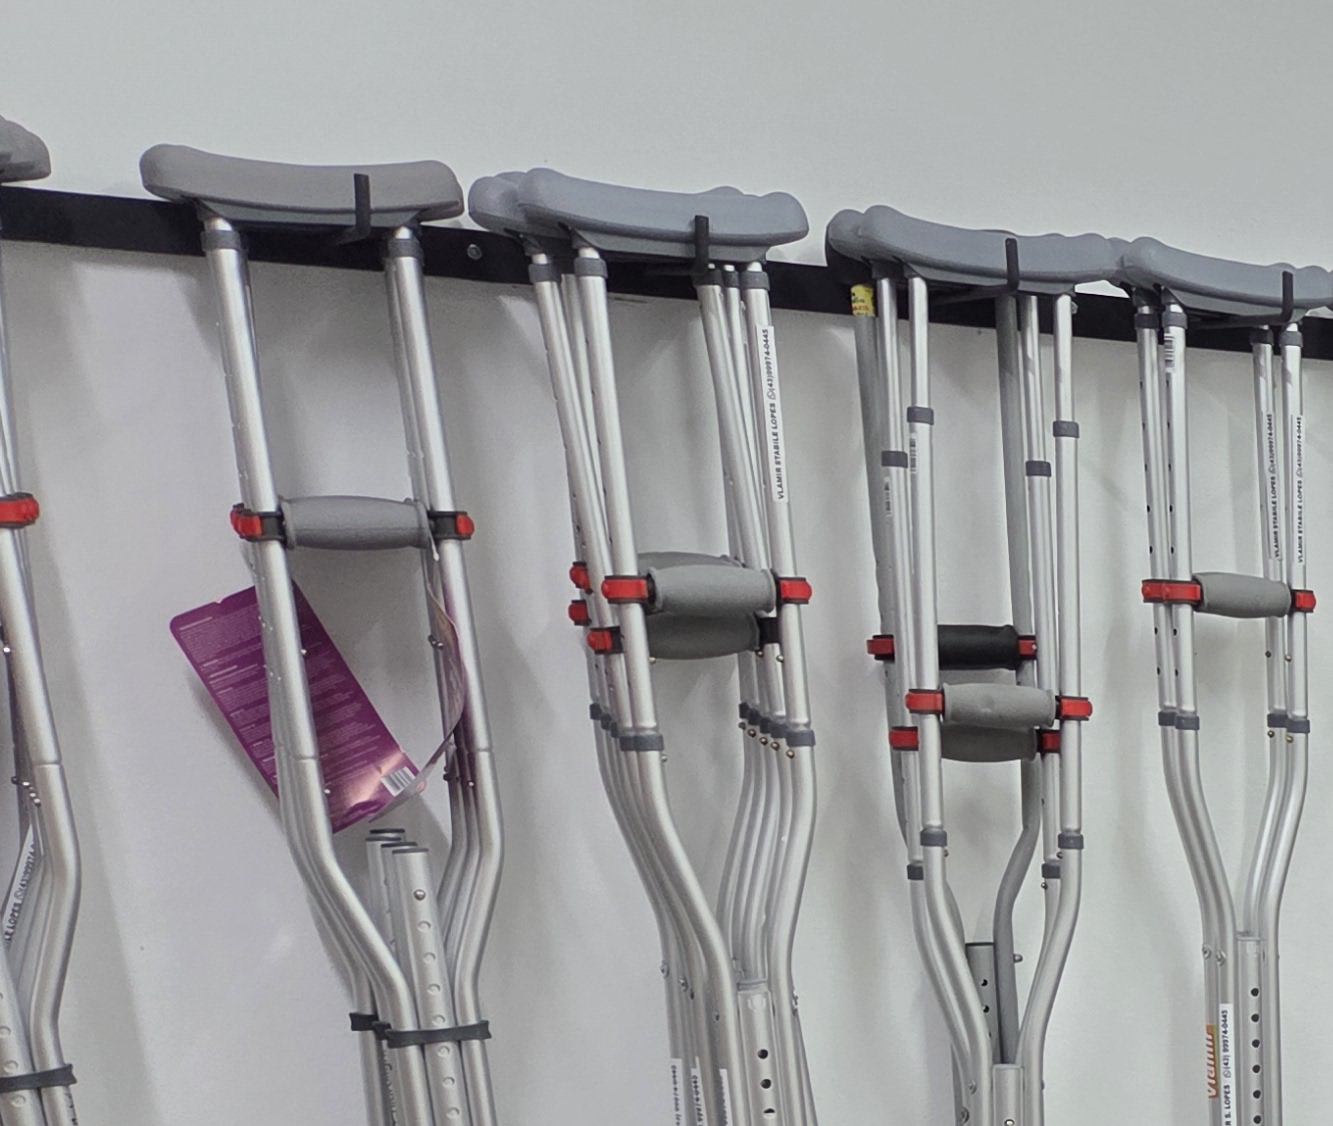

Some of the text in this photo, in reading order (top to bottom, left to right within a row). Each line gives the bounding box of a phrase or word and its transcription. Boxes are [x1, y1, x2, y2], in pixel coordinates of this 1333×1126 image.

[769, 402, 779, 430] LOPES
[771, 431, 782, 466] STABILE
[775, 467, 784, 500] VLAMIR
[1222, 1055, 1231, 1070] (43)
[1223, 1084, 1231, 1110] LOPES
